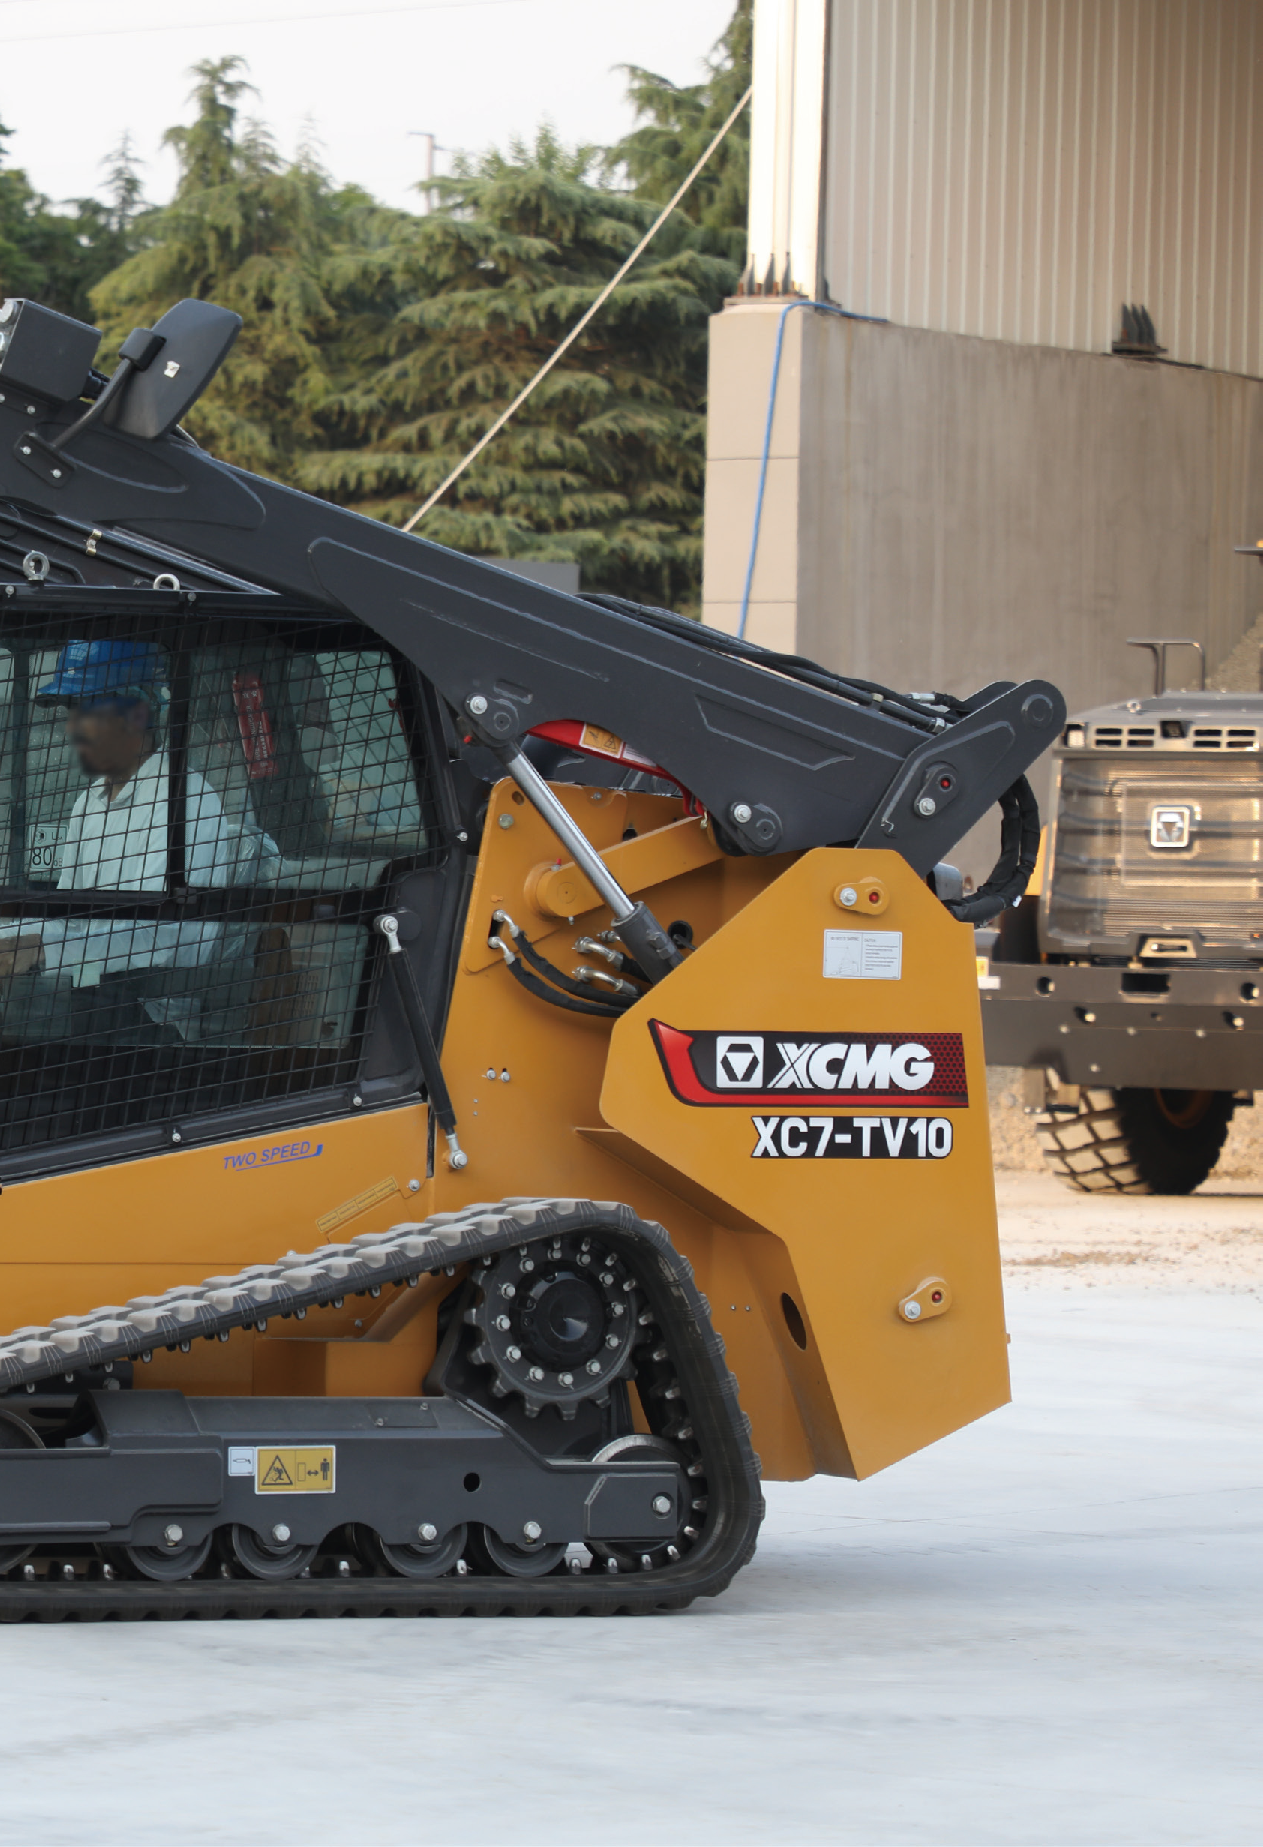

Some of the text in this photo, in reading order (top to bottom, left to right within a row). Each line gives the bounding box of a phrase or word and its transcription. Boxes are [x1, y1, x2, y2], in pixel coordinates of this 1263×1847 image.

[766, 1042, 935, 1090] XCMG
[223, 1140, 311, 1170] TWO SPEED
[751, 1116, 953, 1158] XC7-TV10
